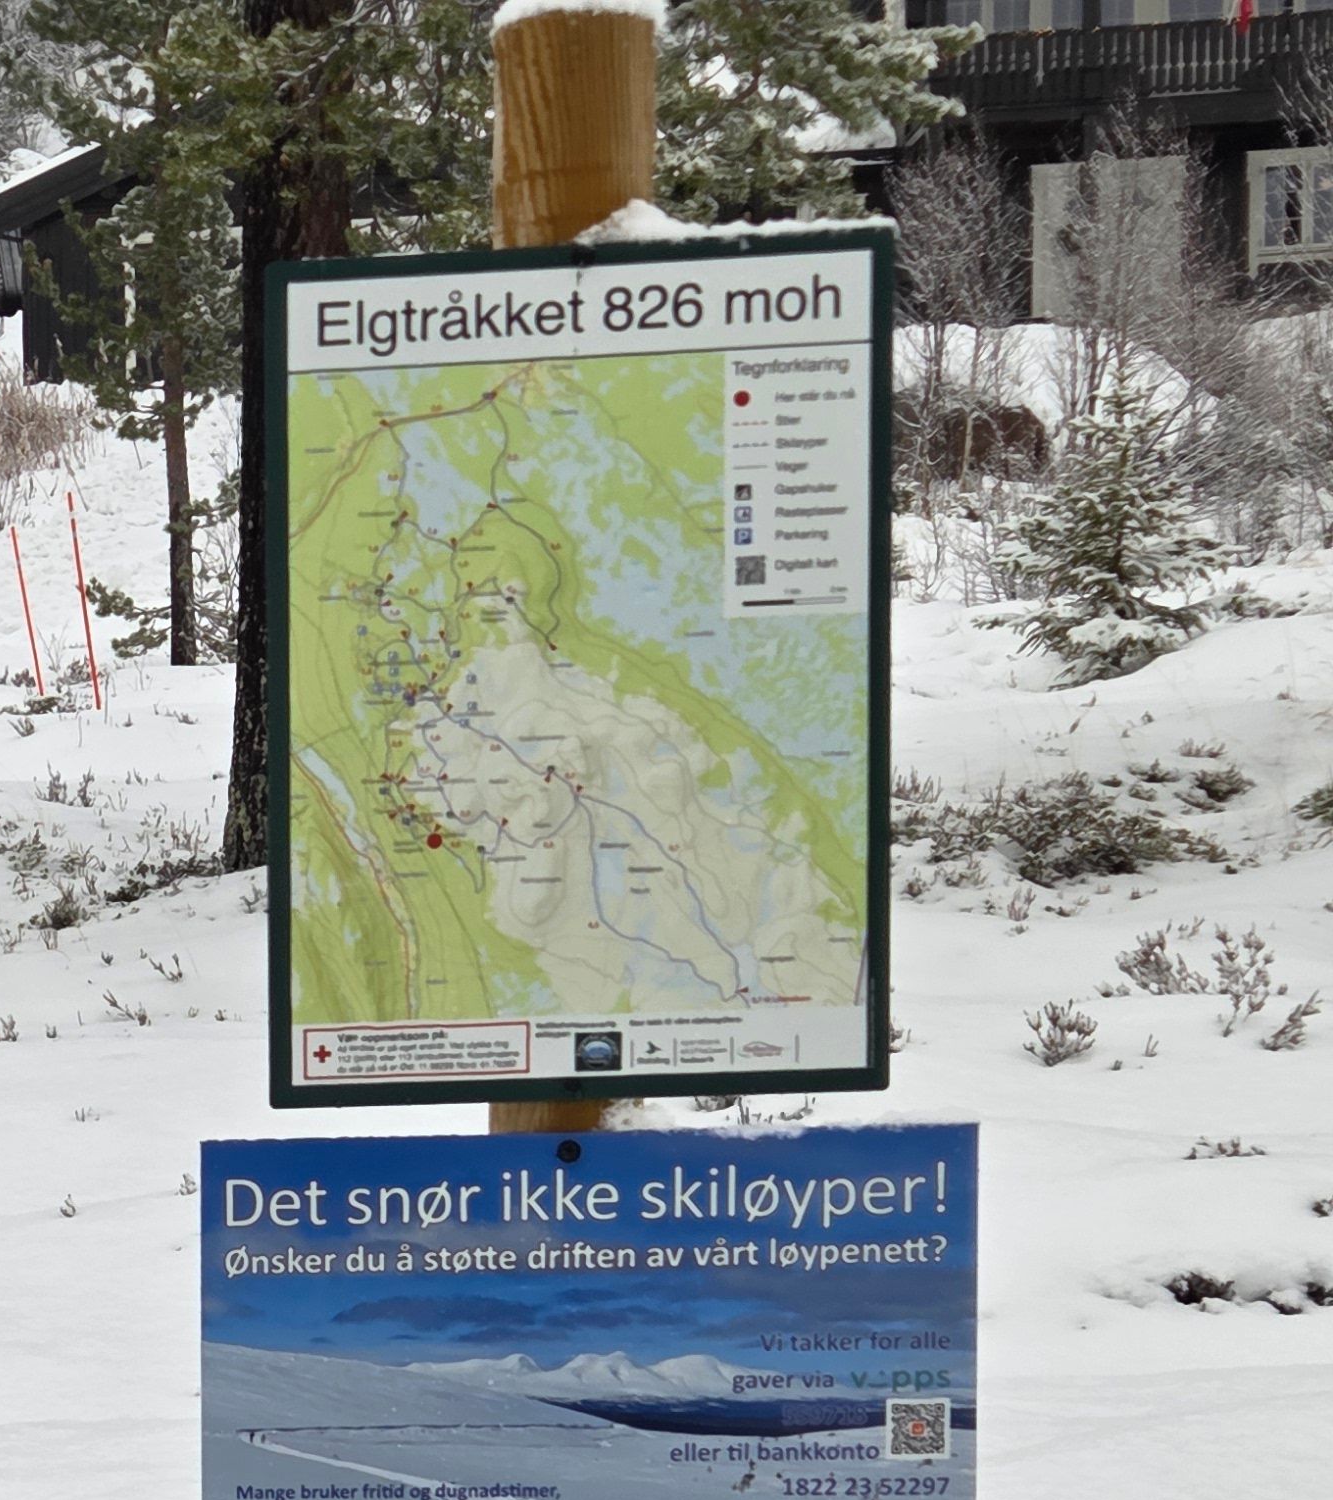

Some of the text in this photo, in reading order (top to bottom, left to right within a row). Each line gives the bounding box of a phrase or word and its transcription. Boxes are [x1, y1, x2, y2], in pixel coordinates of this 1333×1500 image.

[318, 274, 843, 357] Elgtråkket 826 moh
[732, 358, 850, 379] Tegnforklaring
[225, 1161, 946, 1229] Det snør ikke skiløyper!
[224, 1234, 948, 1278] Ønsker du å støtte driften av vårt løypenett?
[760, 1331, 951, 1351] Vi takker for alle
[732, 1373, 794, 1394] gaver
[801, 1371, 835, 1389] via
[670, 1442, 880, 1462] eller til bankkonto
[300, 1484, 358, 1500] bruker
[362, 1483, 405, 1500] fritid
[783, 1476, 950, 1496] 1822 23 52297
